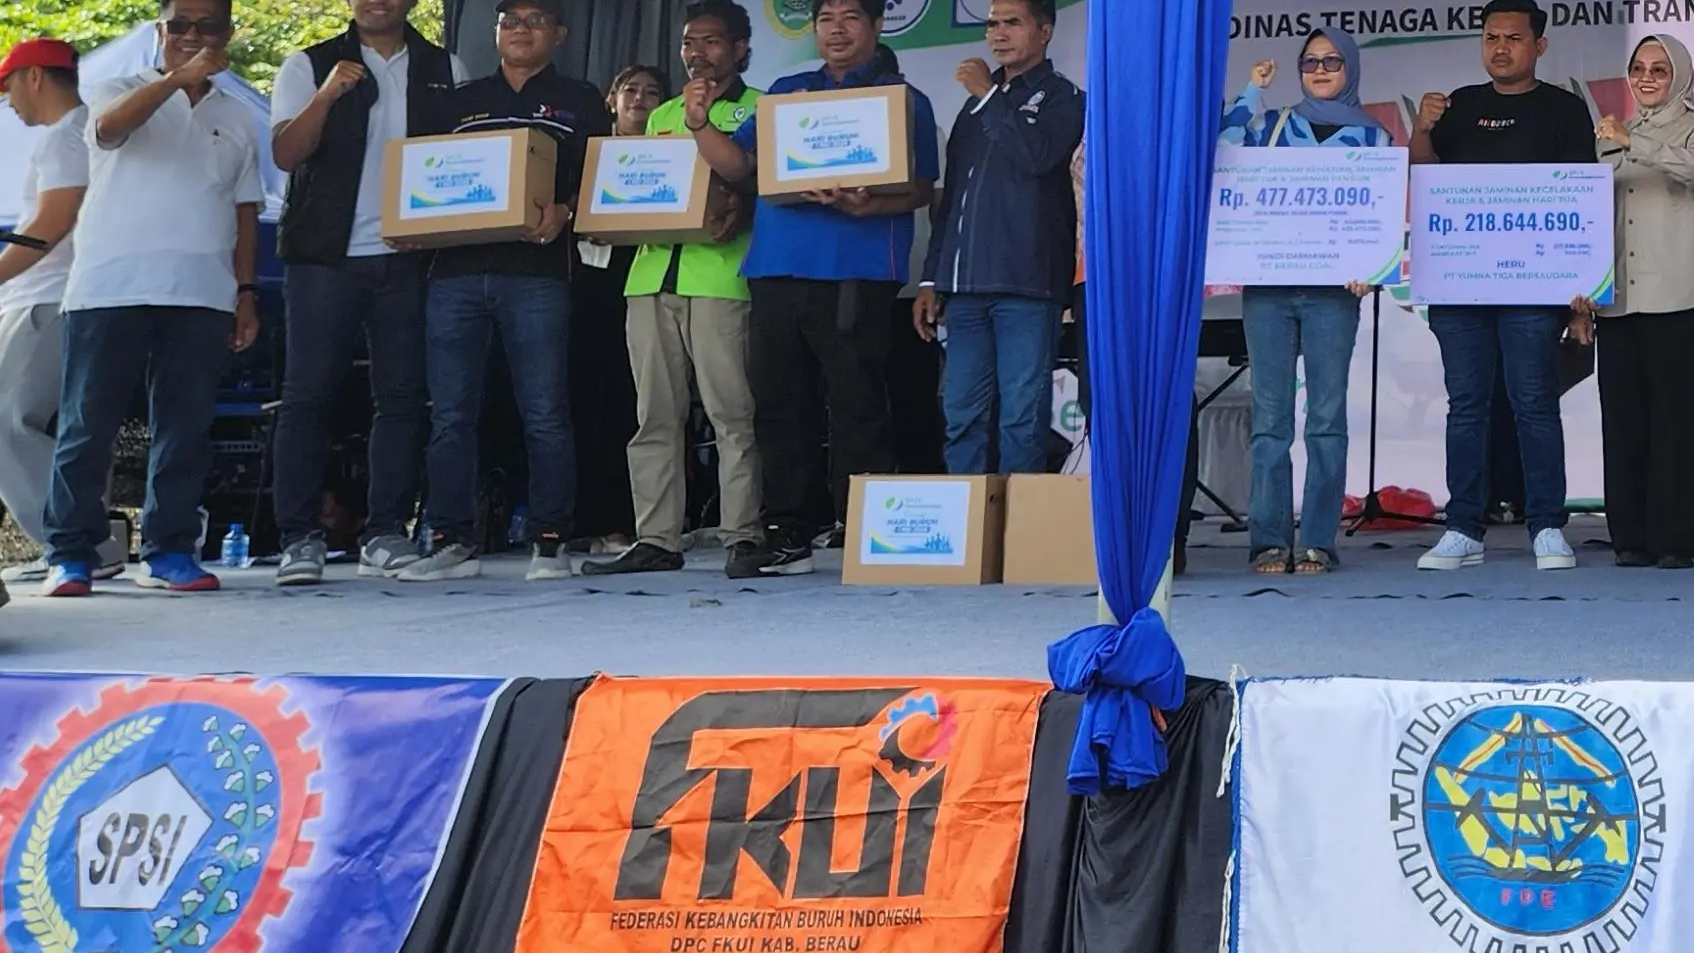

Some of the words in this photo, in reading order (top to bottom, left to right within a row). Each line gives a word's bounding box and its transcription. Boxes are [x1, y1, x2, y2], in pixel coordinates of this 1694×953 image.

[1320, 6, 1438, 33] TENAGA
[1552, 1, 1613, 27] DAN
[1219, 188, 1249, 210] Rp.
[1256, 187, 1385, 209] 477.473.090,-
[1429, 213, 1458, 236] Rp.
[1465, 211, 1594, 234] 218.644.690,-
[1496, 260, 1526, 269] HERU
[89, 813, 187, 885] SPSI
[611, 911, 681, 931] FEDERASI
[685, 910, 793, 930] KEBANGKITAN
[797, 909, 845, 928] BURUH
[849, 907, 923, 927] INDONESIA
[670, 937, 708, 952] DPC
[712, 936, 755, 952] FKUI
[760, 936, 800, 952] KAB.
[805, 935, 861, 952] BERAU
